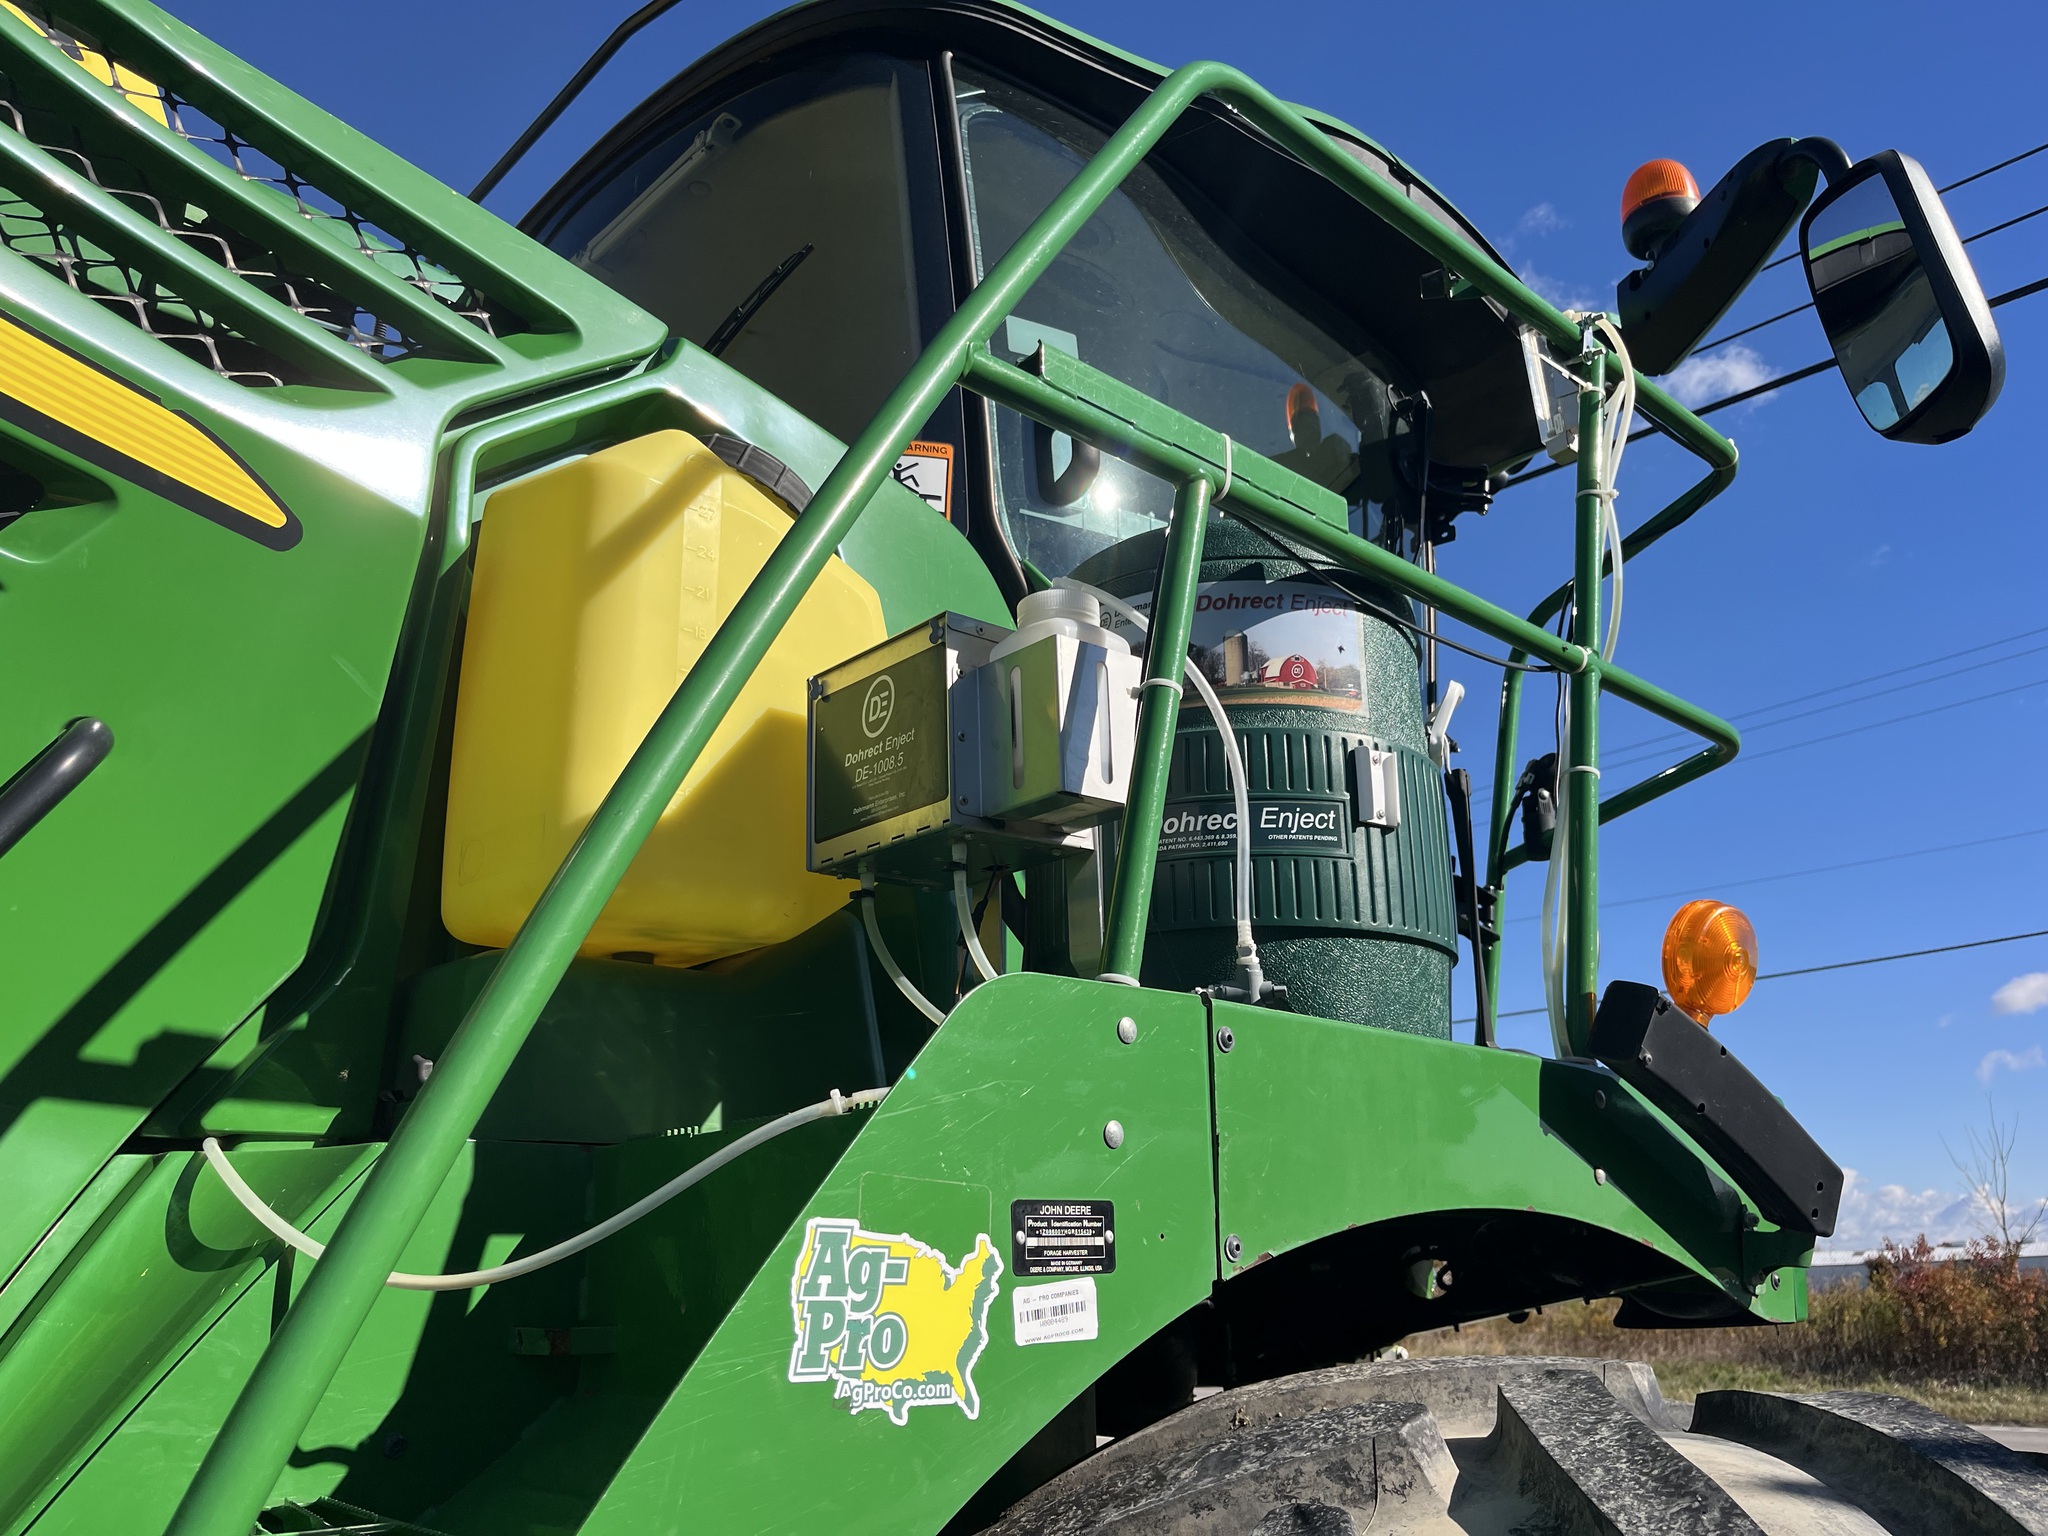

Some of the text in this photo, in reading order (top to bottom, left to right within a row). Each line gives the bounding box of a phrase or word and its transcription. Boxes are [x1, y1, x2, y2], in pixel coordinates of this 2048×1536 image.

[907, 443, 948, 454] ARNING
[698, 546, 716, 561] 24
[696, 586, 710, 600] 21
[1196, 593, 1348, 617] Dohrect Enject
[695, 626, 707, 640] 18
[868, 690, 889, 723] DE
[845, 728, 915, 767] Dohrect Enject
[855, 751, 904, 783] DE-1008.5
[1162, 807, 1337, 835] ohrec Enject
[1158, 837, 1177, 845] ATENT
[1040, 1205, 1092, 1215] JOHN DEERE
[1027, 1219, 1102, 1227] Product Identification Number
[799, 1227, 910, 1316] Ag-
[1050, 1289, 1079, 1300] COMPANIES
[796, 1300, 908, 1373] Pro
[839, 1380, 952, 1403] AgProCo.com
